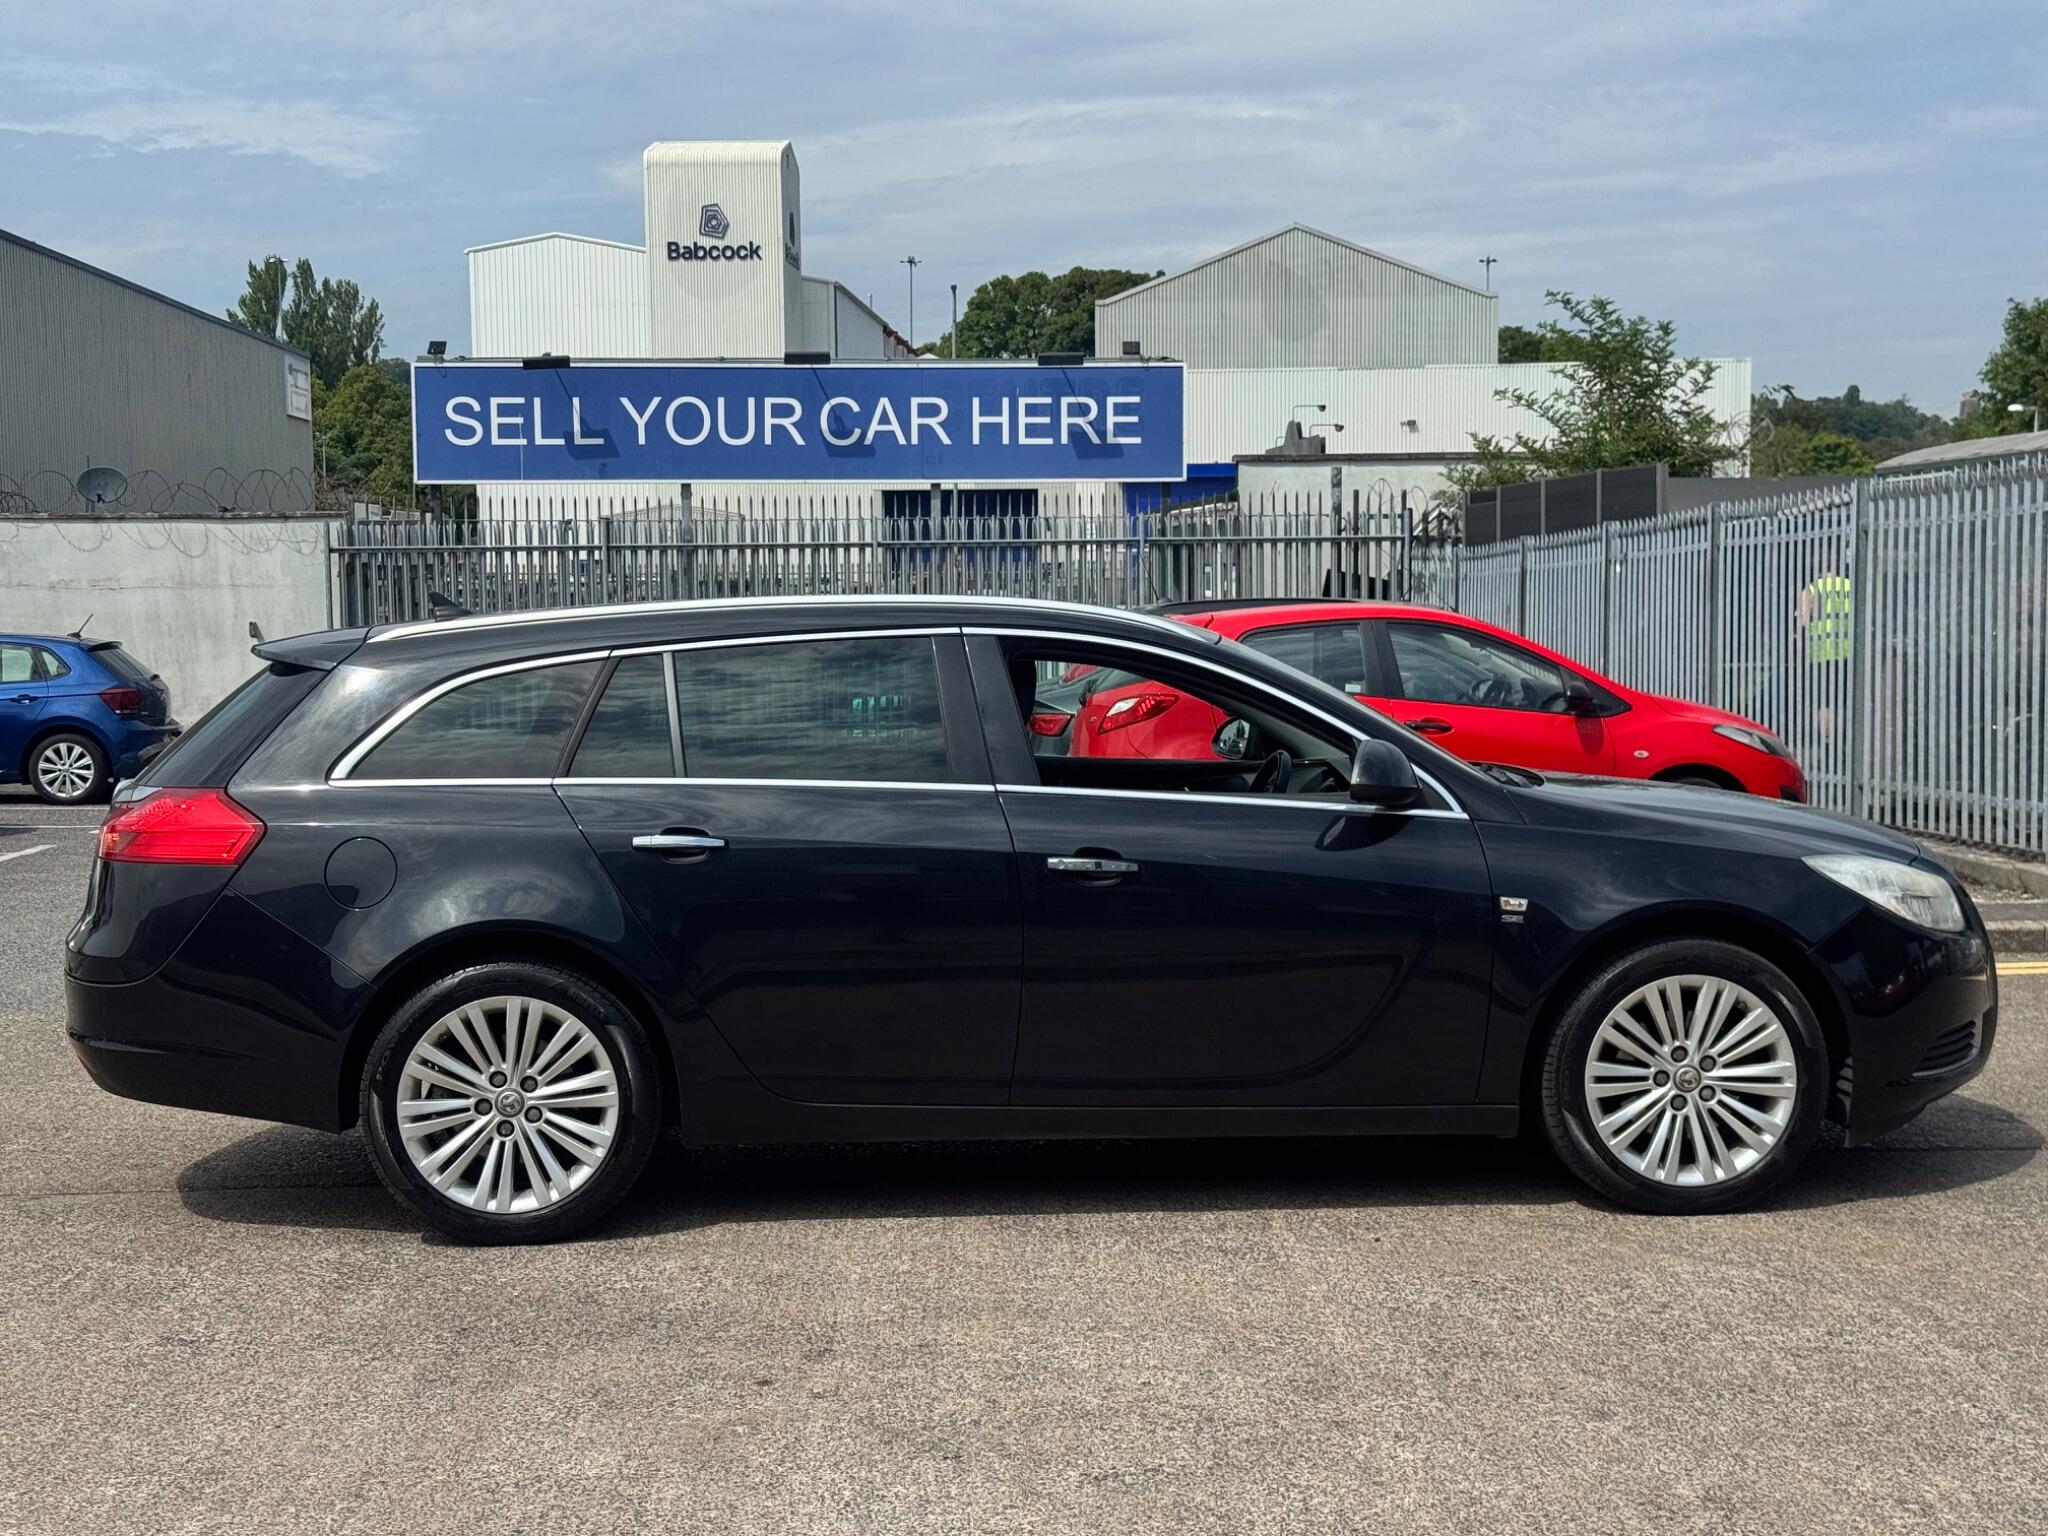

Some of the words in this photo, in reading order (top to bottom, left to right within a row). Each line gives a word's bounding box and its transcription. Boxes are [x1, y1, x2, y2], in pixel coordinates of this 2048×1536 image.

[667, 241, 762, 261] Babcock
[445, 396, 603, 446] SELL
[620, 396, 805, 446] YOUR
[820, 396, 952, 446] CAR
[973, 396, 1141, 445] HERE
